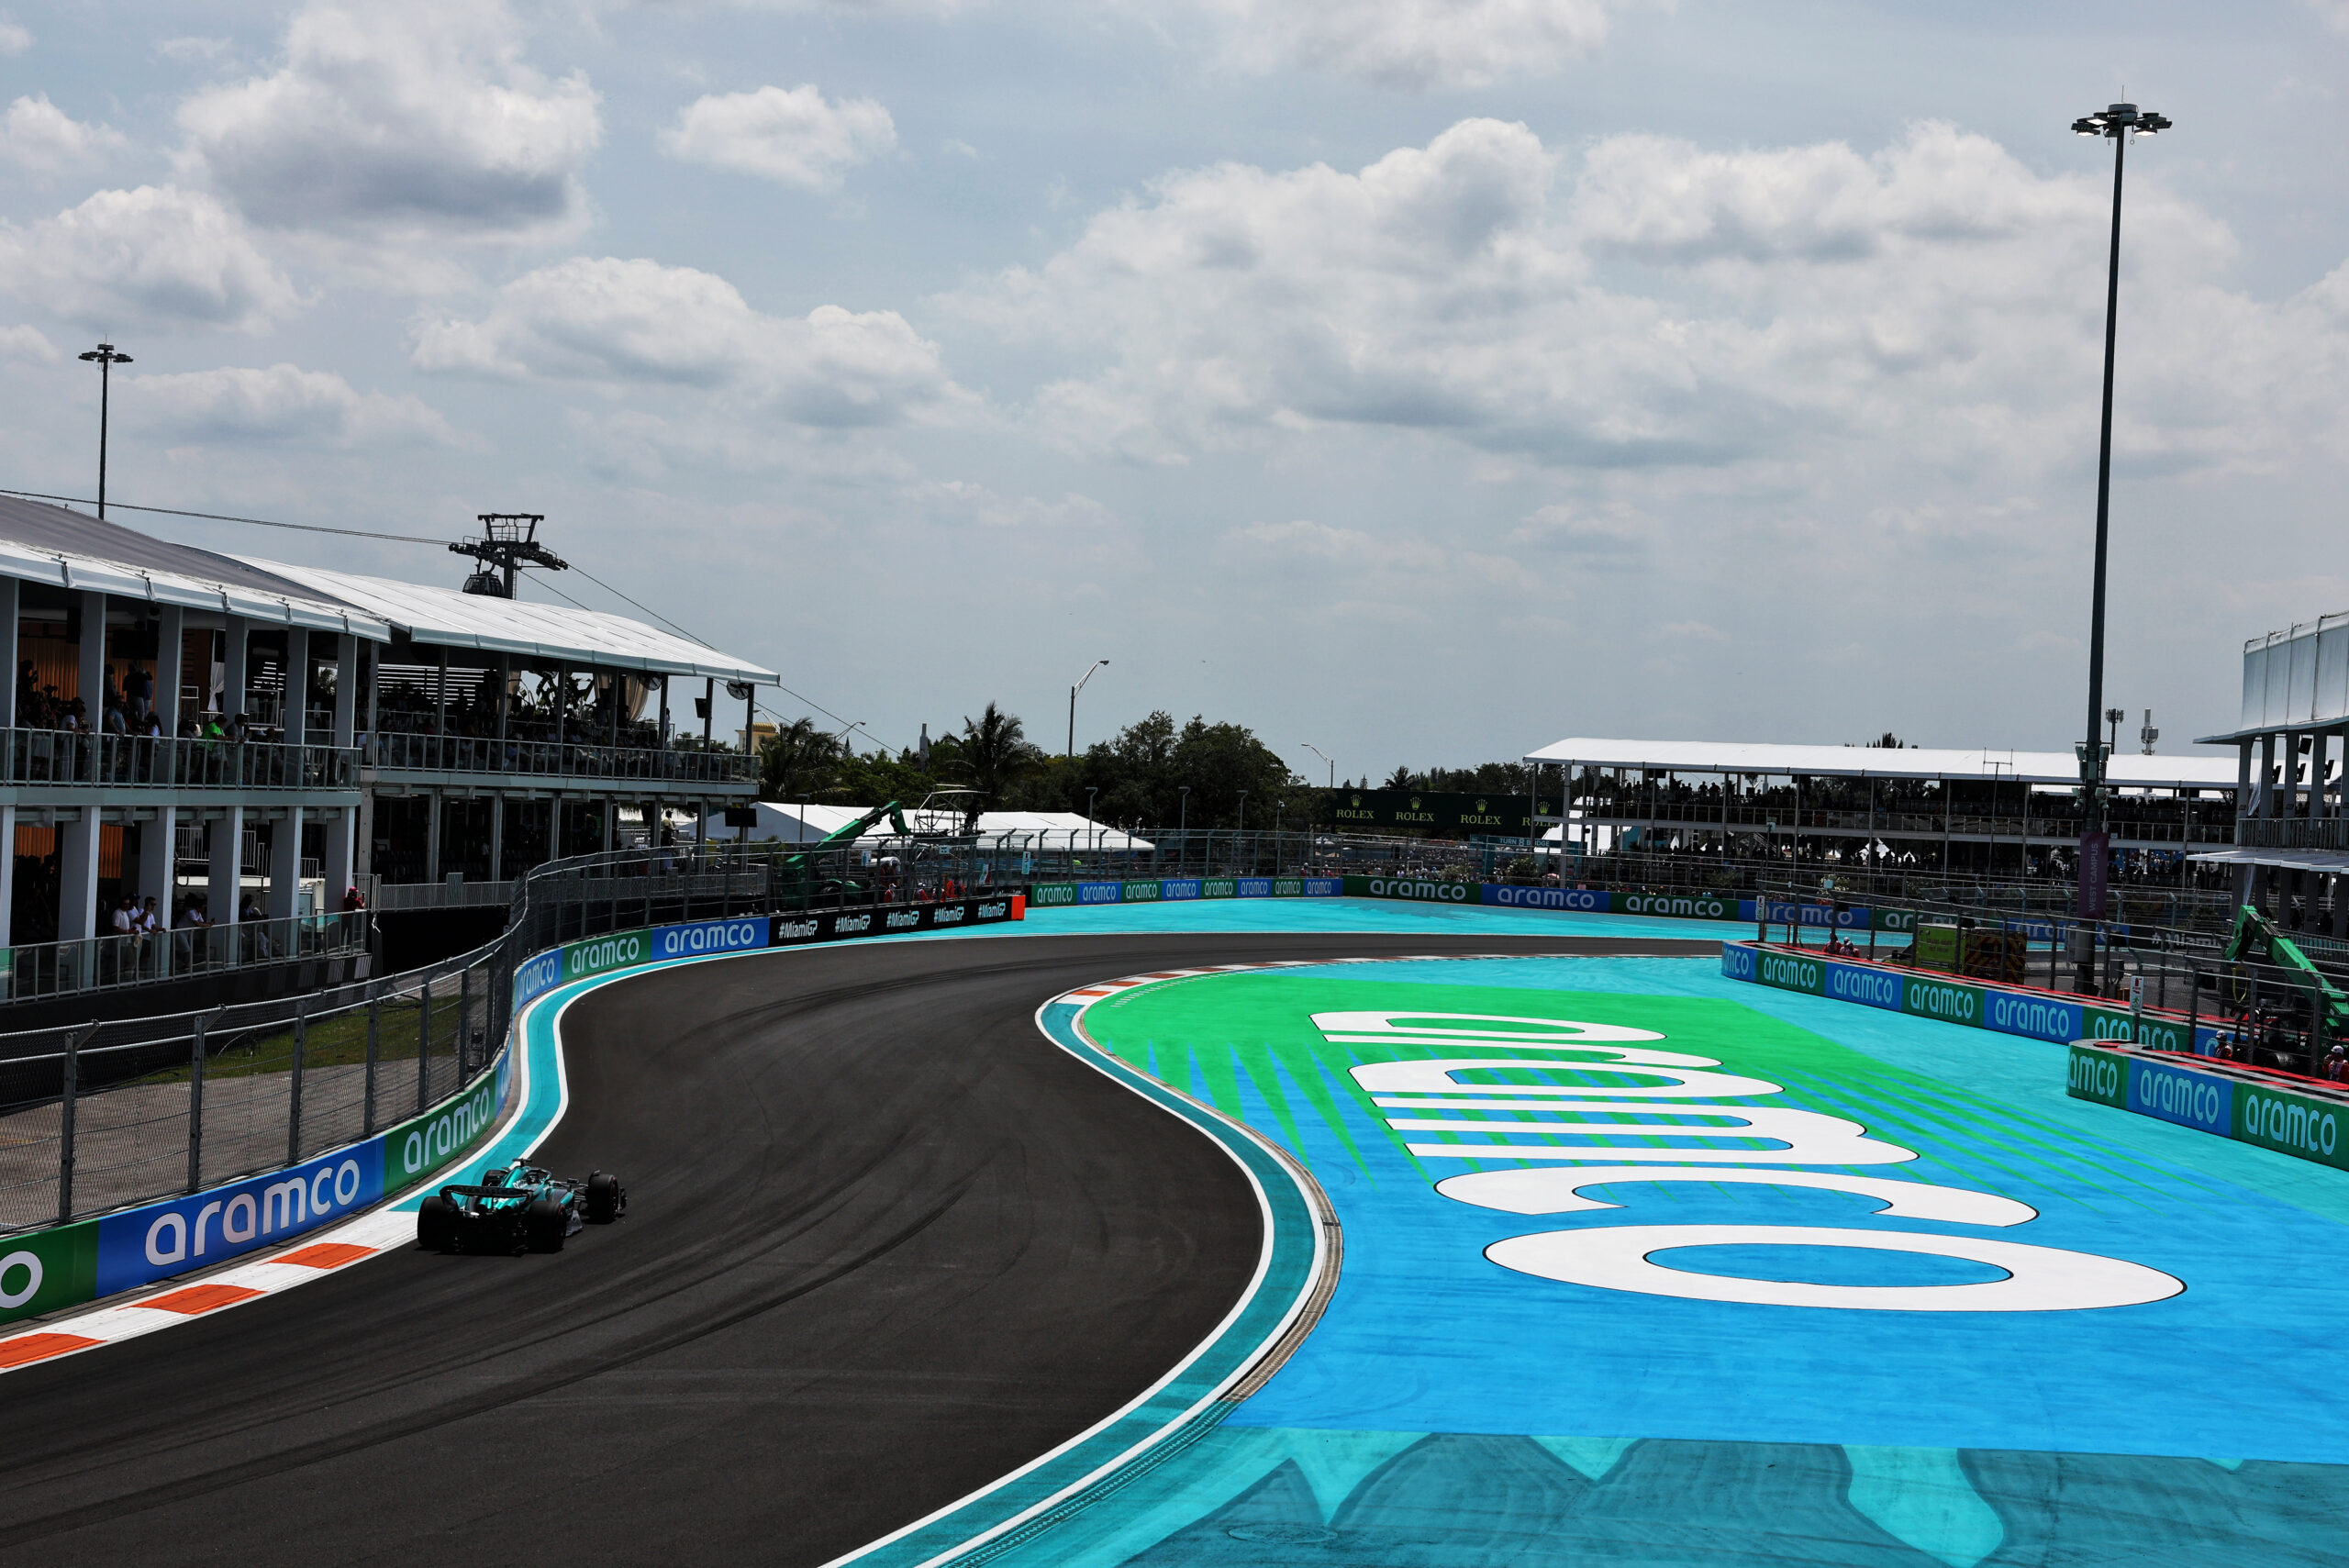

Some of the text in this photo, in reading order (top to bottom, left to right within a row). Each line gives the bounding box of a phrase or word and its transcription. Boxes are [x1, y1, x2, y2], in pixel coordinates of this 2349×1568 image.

[1336, 809, 1375, 819] ROLEX
[1396, 811, 1434, 822] ROLEX
[1460, 814, 1501, 825] ROLEX
[1499, 838, 1517, 846] TURN
[1518, 837, 1525, 847] 8
[2088, 843, 2099, 911] WEST CAMPUS
[1037, 887, 1073, 903] aramco
[1083, 885, 1117, 901] aramco
[1126, 884, 1158, 899] aramco
[1166, 882, 1197, 897] aramco
[1205, 881, 1233, 896] aramco
[1241, 881, 1268, 895] aramco
[1275, 880, 1301, 895] aramco
[1307, 880, 1331, 895] aramco
[1370, 879, 1466, 901] aramco
[1497, 887, 1595, 908] aramco
[933, 906, 964, 923] #MiamiGP
[977, 902, 1006, 918] #MiamiGP
[1626, 895, 1723, 917] aramco
[779, 919, 818, 939] #MiamiGP
[835, 914, 871, 932] #MiamiGP
[886, 910, 919, 928] #MiamiGP
[665, 923, 755, 953] aramco
[572, 937, 640, 973] aramco
[518, 958, 555, 1002] aramco
[1764, 956, 1816, 988] aramco
[1835, 969, 1893, 1004] aramco
[1910, 983, 1974, 1019] aramco
[1995, 997, 2069, 1038] aramco
[2140, 1069, 2219, 1124] aramco
[404, 1086, 490, 1174] aramco
[2245, 1094, 2336, 1156] aramco
[1308, 1010, 2188, 1312] aramco
[145, 1159, 360, 1266] aramco
